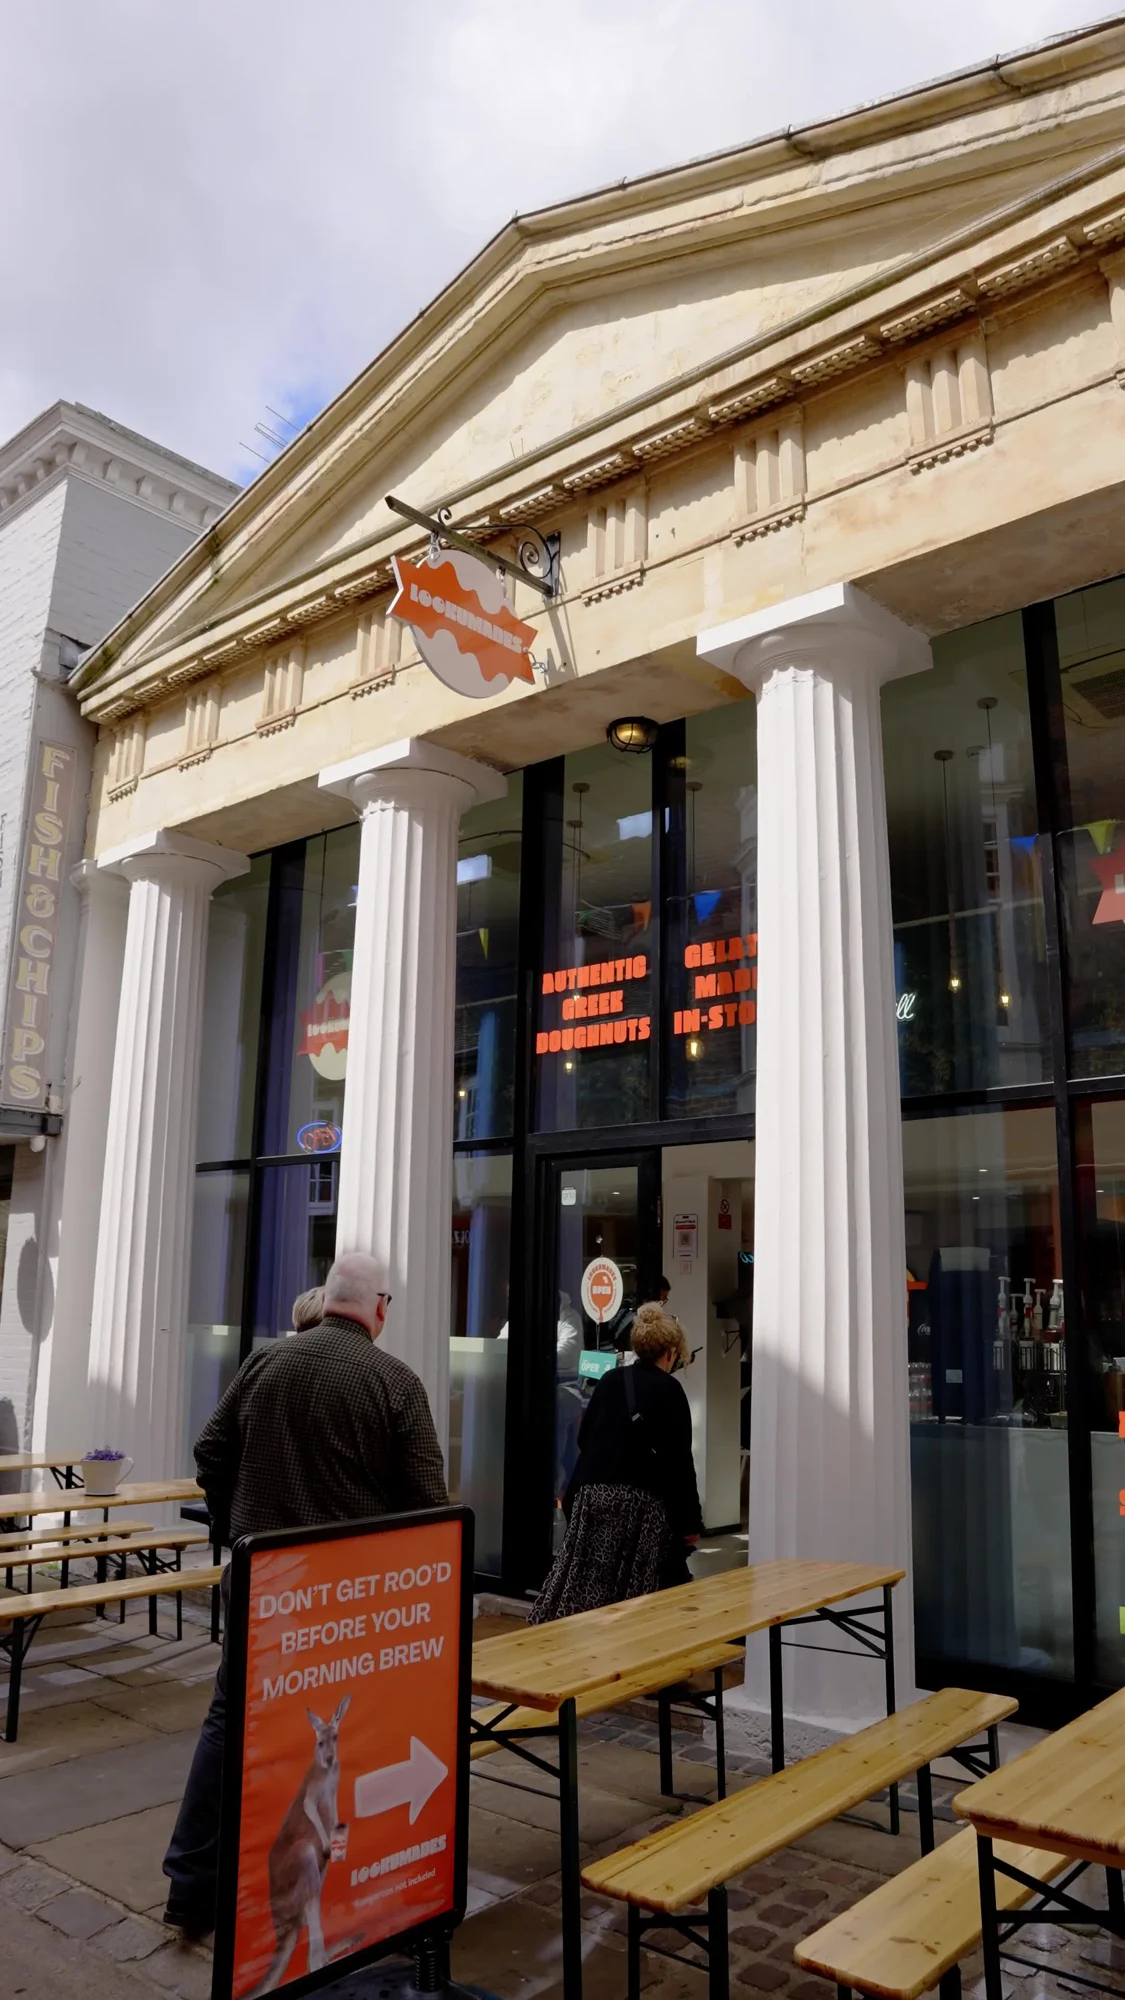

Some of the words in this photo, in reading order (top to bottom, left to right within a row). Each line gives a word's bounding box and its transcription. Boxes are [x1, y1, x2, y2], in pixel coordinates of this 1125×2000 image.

[410, 583, 523, 654] LOOKUMADES
[28, 745, 70, 881] FISH
[26, 884, 55, 919] &
[684, 933, 758, 969] GELAT
[542, 955, 647, 995] AUTHENTIC
[8, 924, 52, 1100] CHIPS
[562, 990, 624, 1020] GREEK
[673, 1000, 756, 1035] IN-STO
[536, 1016, 651, 1054] DOUGHNUTS
[303, 1125, 337, 1151] OPEN
[592, 1285, 611, 1295] OPEN
[580, 1362, 600, 1373] OPEN
[259, 1583, 332, 1619] DON'T
[336, 1574, 380, 1602] GET
[384, 1561, 451, 1593] ROO'D
[281, 1615, 367, 1655] BEFORE
[371, 1602, 431, 1633] YOUR
[262, 1652, 374, 1701] MORNING
[379, 1636, 444, 1671] BREW
[350, 1834, 447, 1887] LOOKUMADES
[394, 1881, 408, 1893] not
[408, 1867, 436, 1887] included
